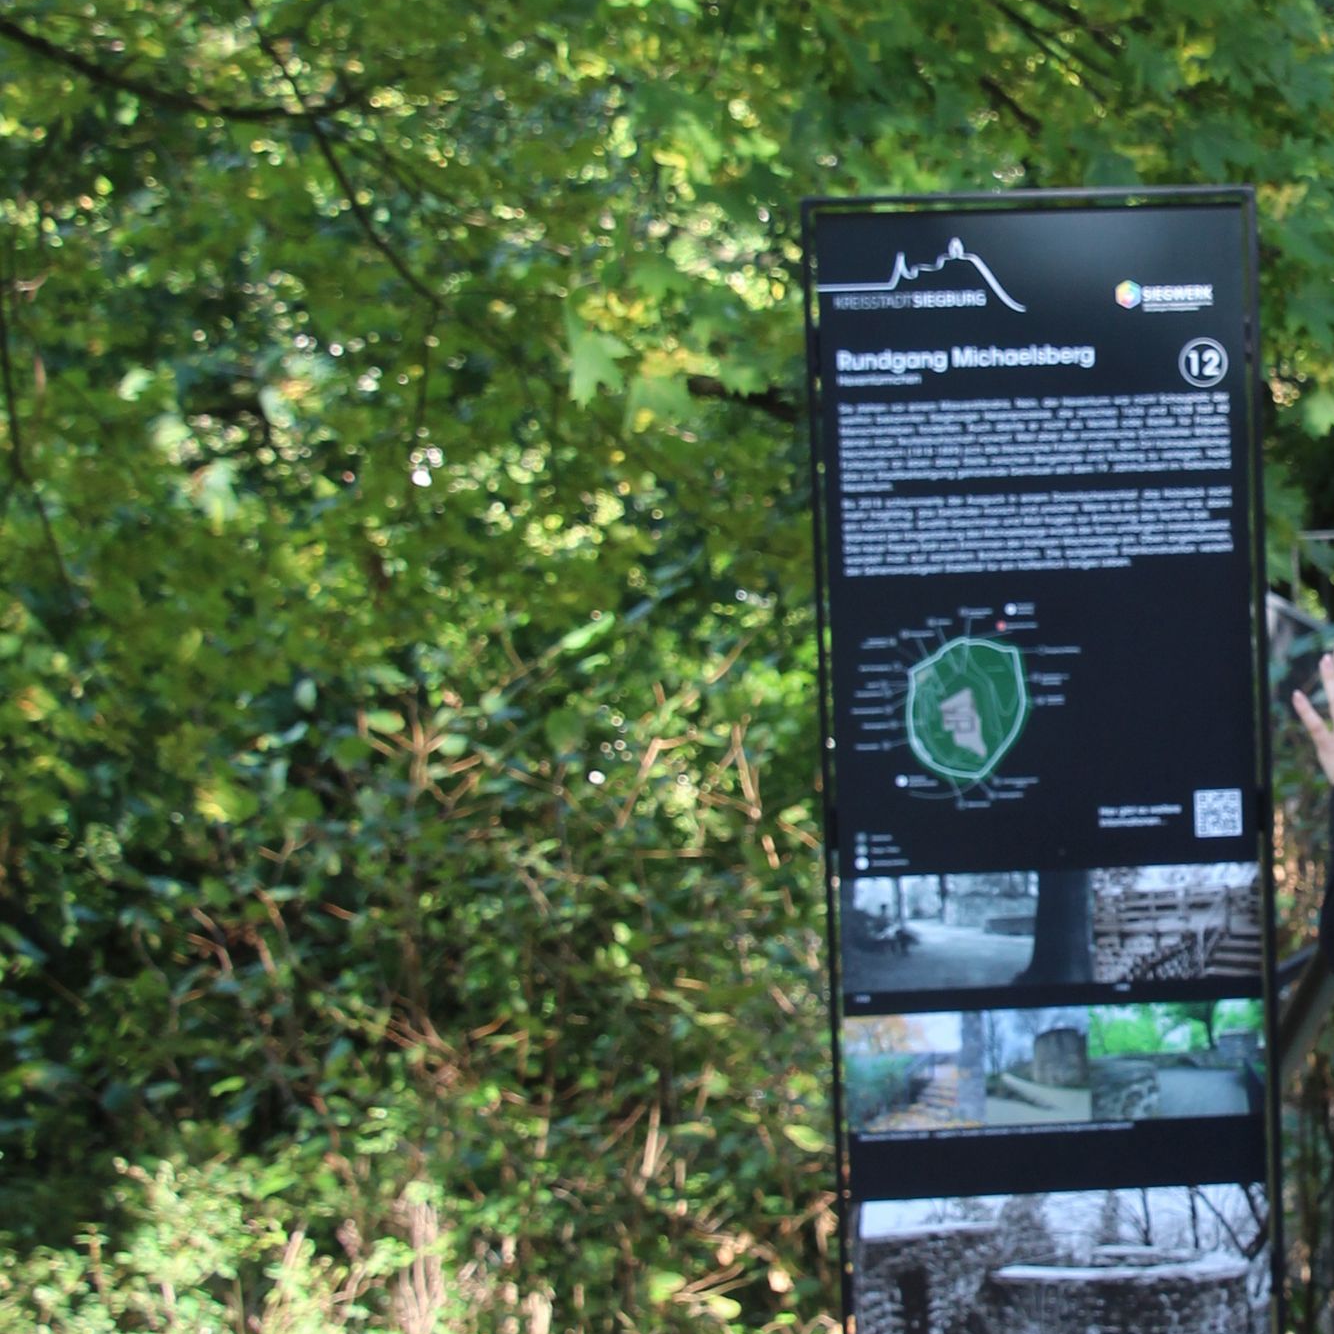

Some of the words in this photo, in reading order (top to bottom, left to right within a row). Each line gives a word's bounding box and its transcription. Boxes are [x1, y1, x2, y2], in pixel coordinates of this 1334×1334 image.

[1142, 284, 1214, 300] SIEGWERK
[835, 348, 949, 373] Rundgang
[951, 343, 1095, 368] Michaelsberg
[1189, 349, 1220, 376] 12
